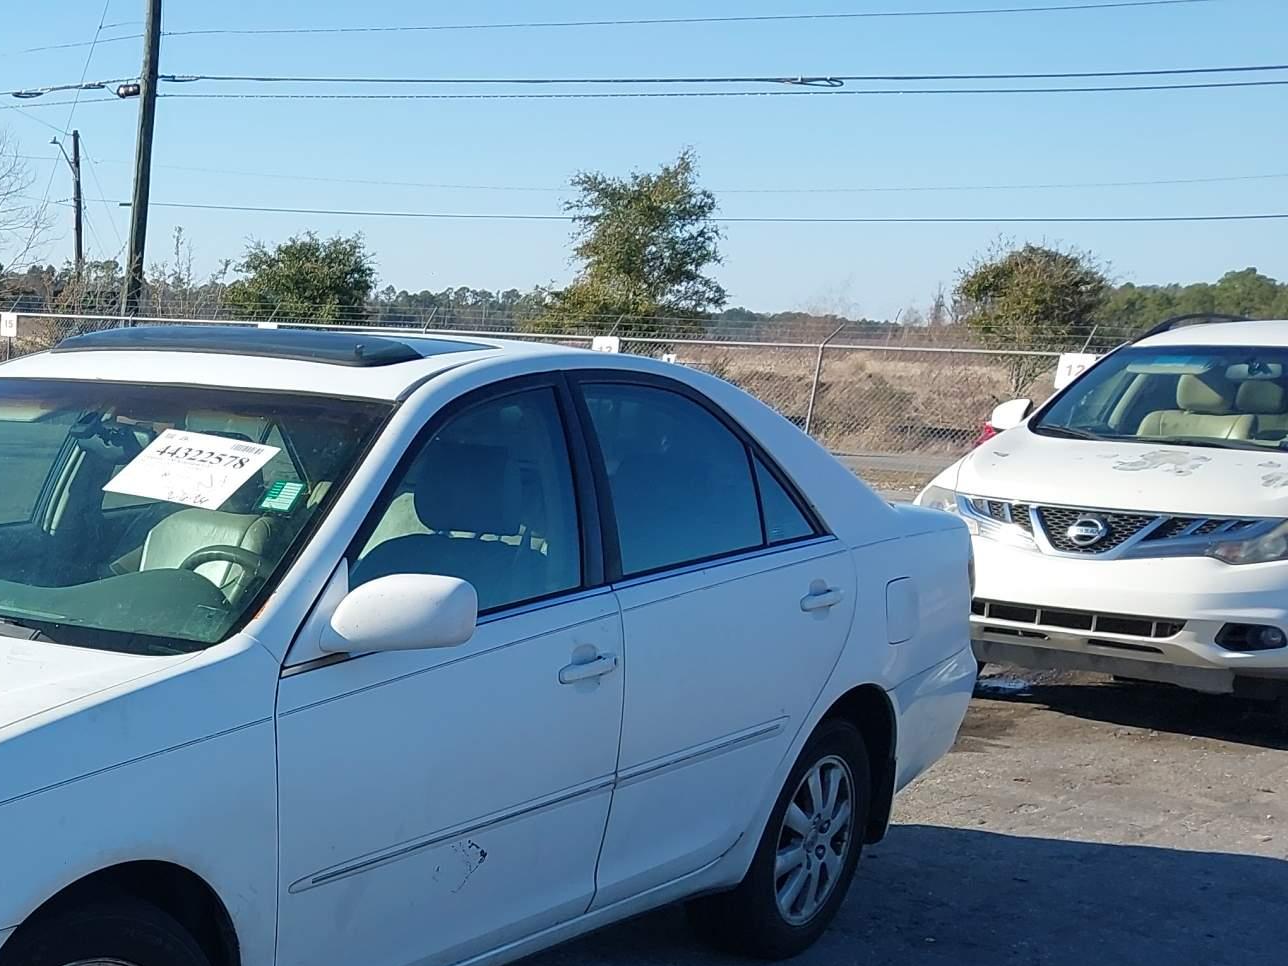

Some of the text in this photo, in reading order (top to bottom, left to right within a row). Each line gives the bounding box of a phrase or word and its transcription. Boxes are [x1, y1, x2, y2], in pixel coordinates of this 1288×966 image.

[5, 319, 14, 329] 15
[1066, 364, 1086, 377] 12
[156, 445, 250, 470] 44322578
